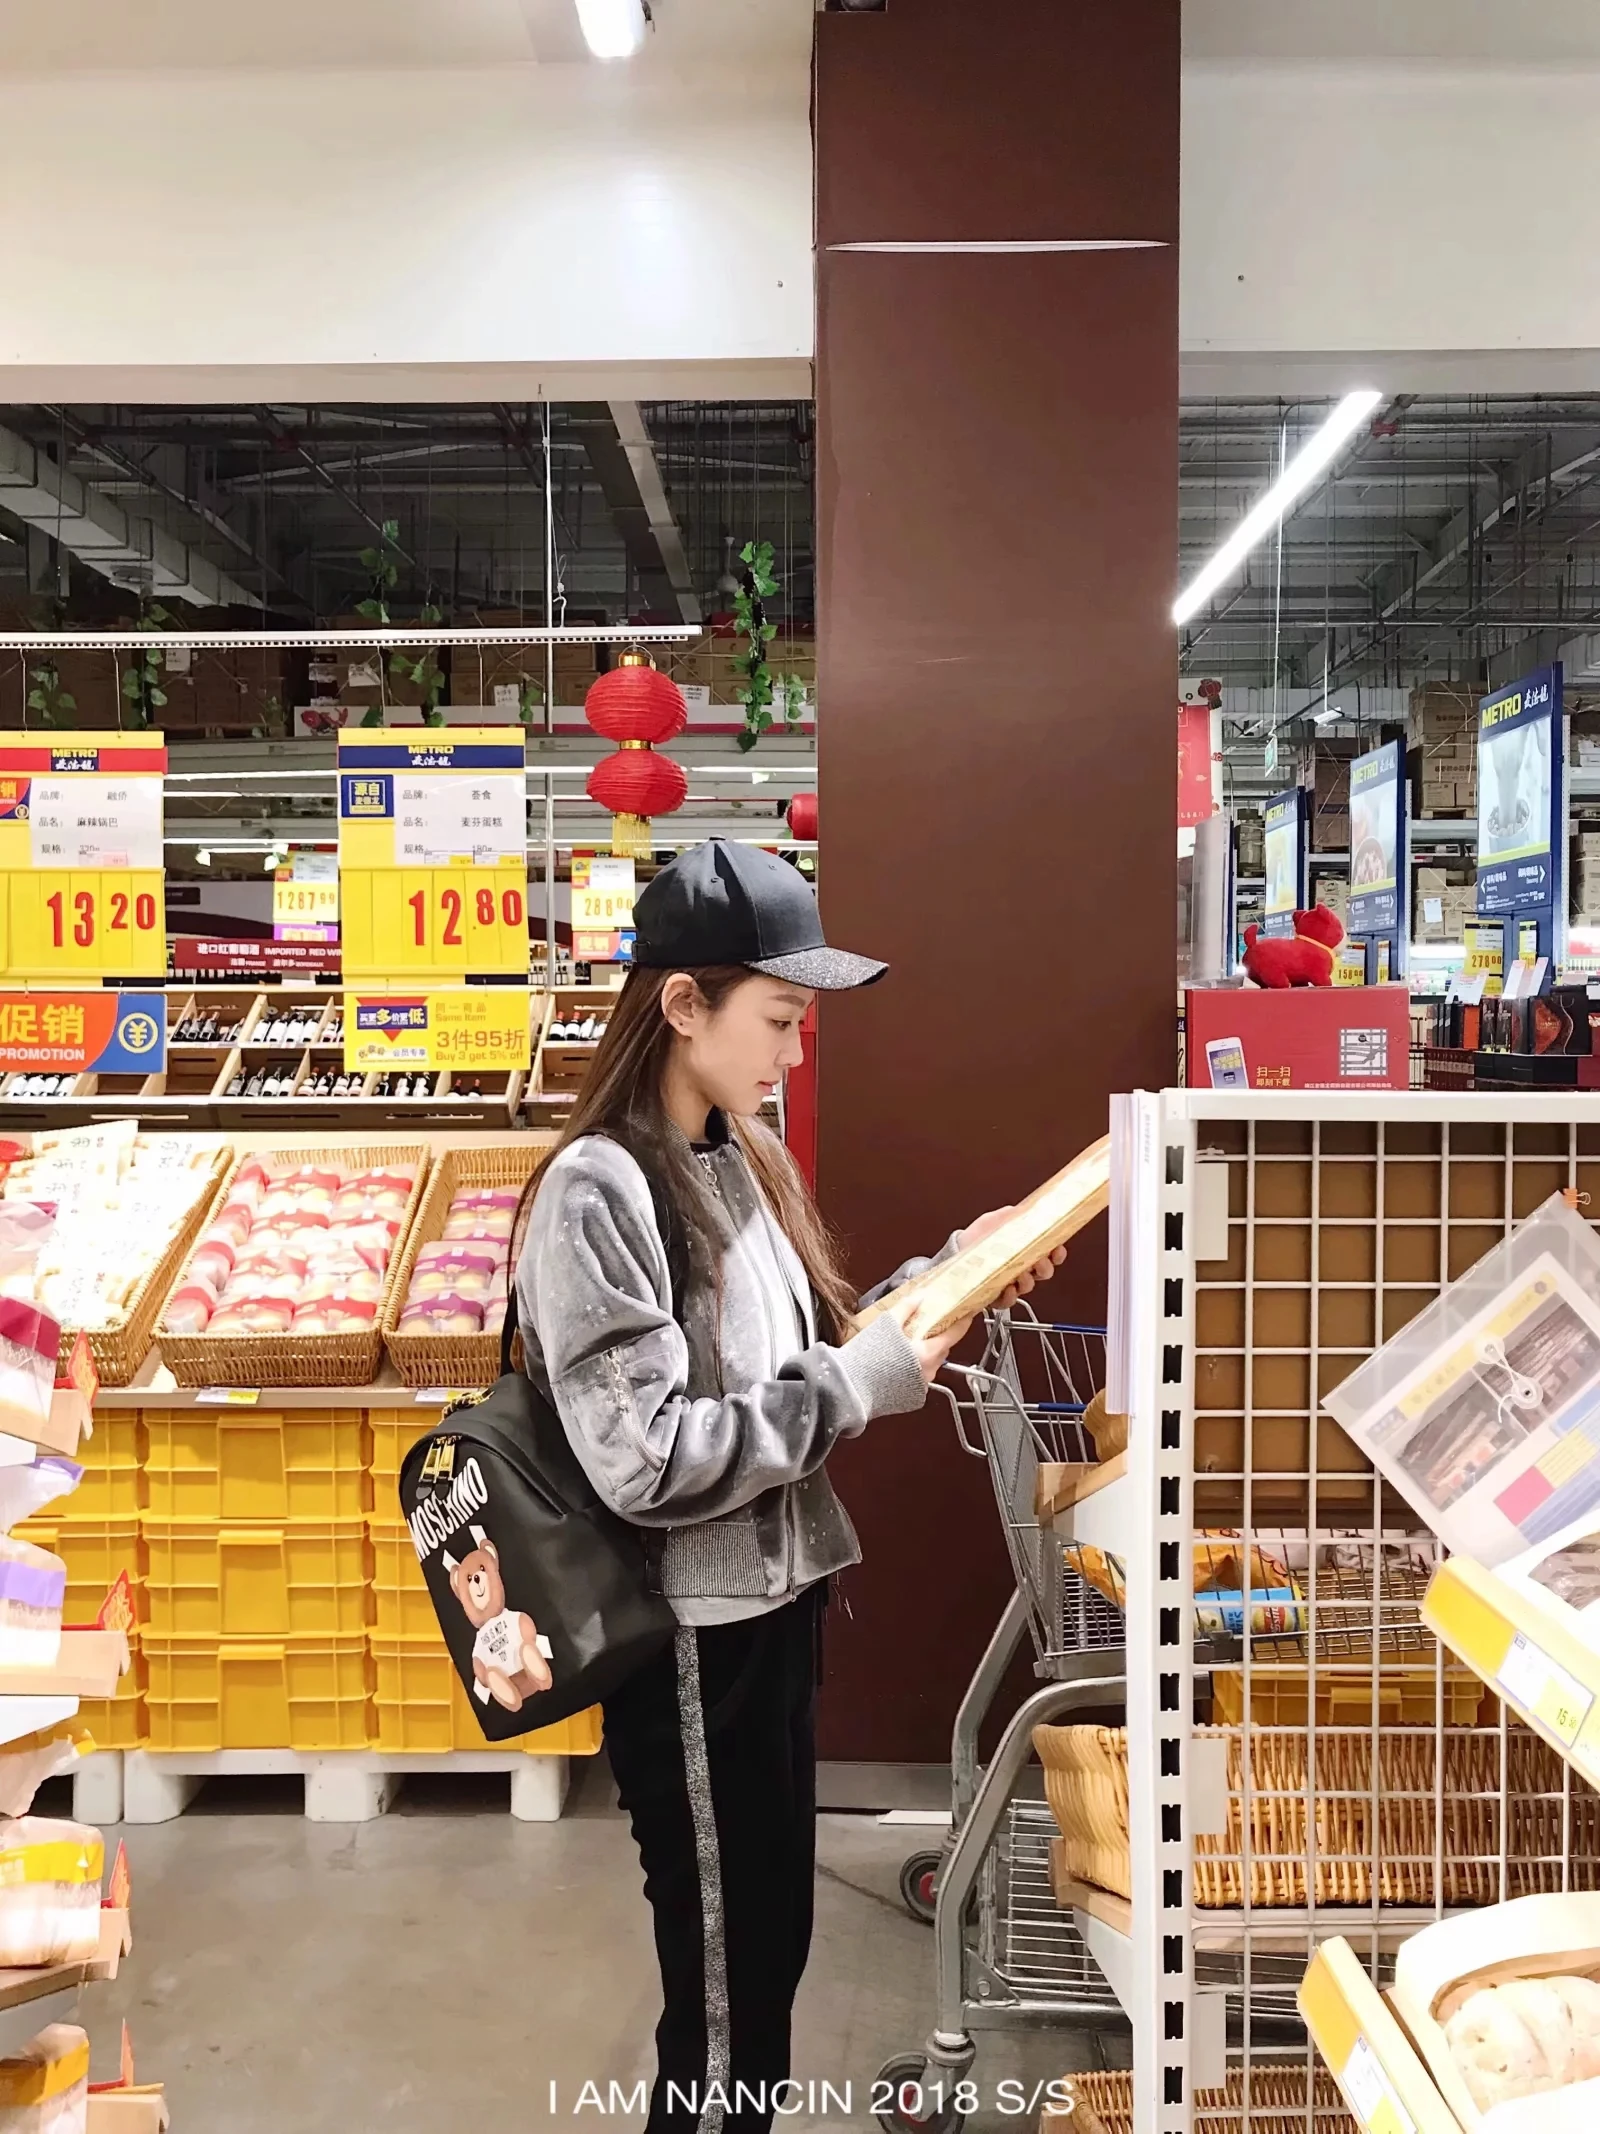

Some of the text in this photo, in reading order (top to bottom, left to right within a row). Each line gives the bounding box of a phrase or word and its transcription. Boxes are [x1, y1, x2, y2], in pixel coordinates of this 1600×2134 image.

[1481, 692, 1522, 729] METRO
[51, 748, 98, 758] METRO
[408, 745, 454, 754] METRO
[1352, 760, 1379, 786] METRO
[76, 816, 119, 828] 麻辣锅巴
[461, 816, 503, 828] 麦芬蛋糕
[264, 947, 307, 956] IMPORTED
[308, 948, 326, 957] RED
[436, 1013, 486, 1022] Same Item
[0, 1004, 85, 1045] 促销
[436, 1028, 526, 1051] 3件95折
[0, 1048, 85, 1061] PROMOTION
[436, 1050, 525, 1063] Buy 3 get 5% off
[1256, 1065, 1291, 1078] 扫一扫
[1256, 1077, 1291, 1087] 即刻下载
[406, 1456, 489, 1563] MOSCHINO
